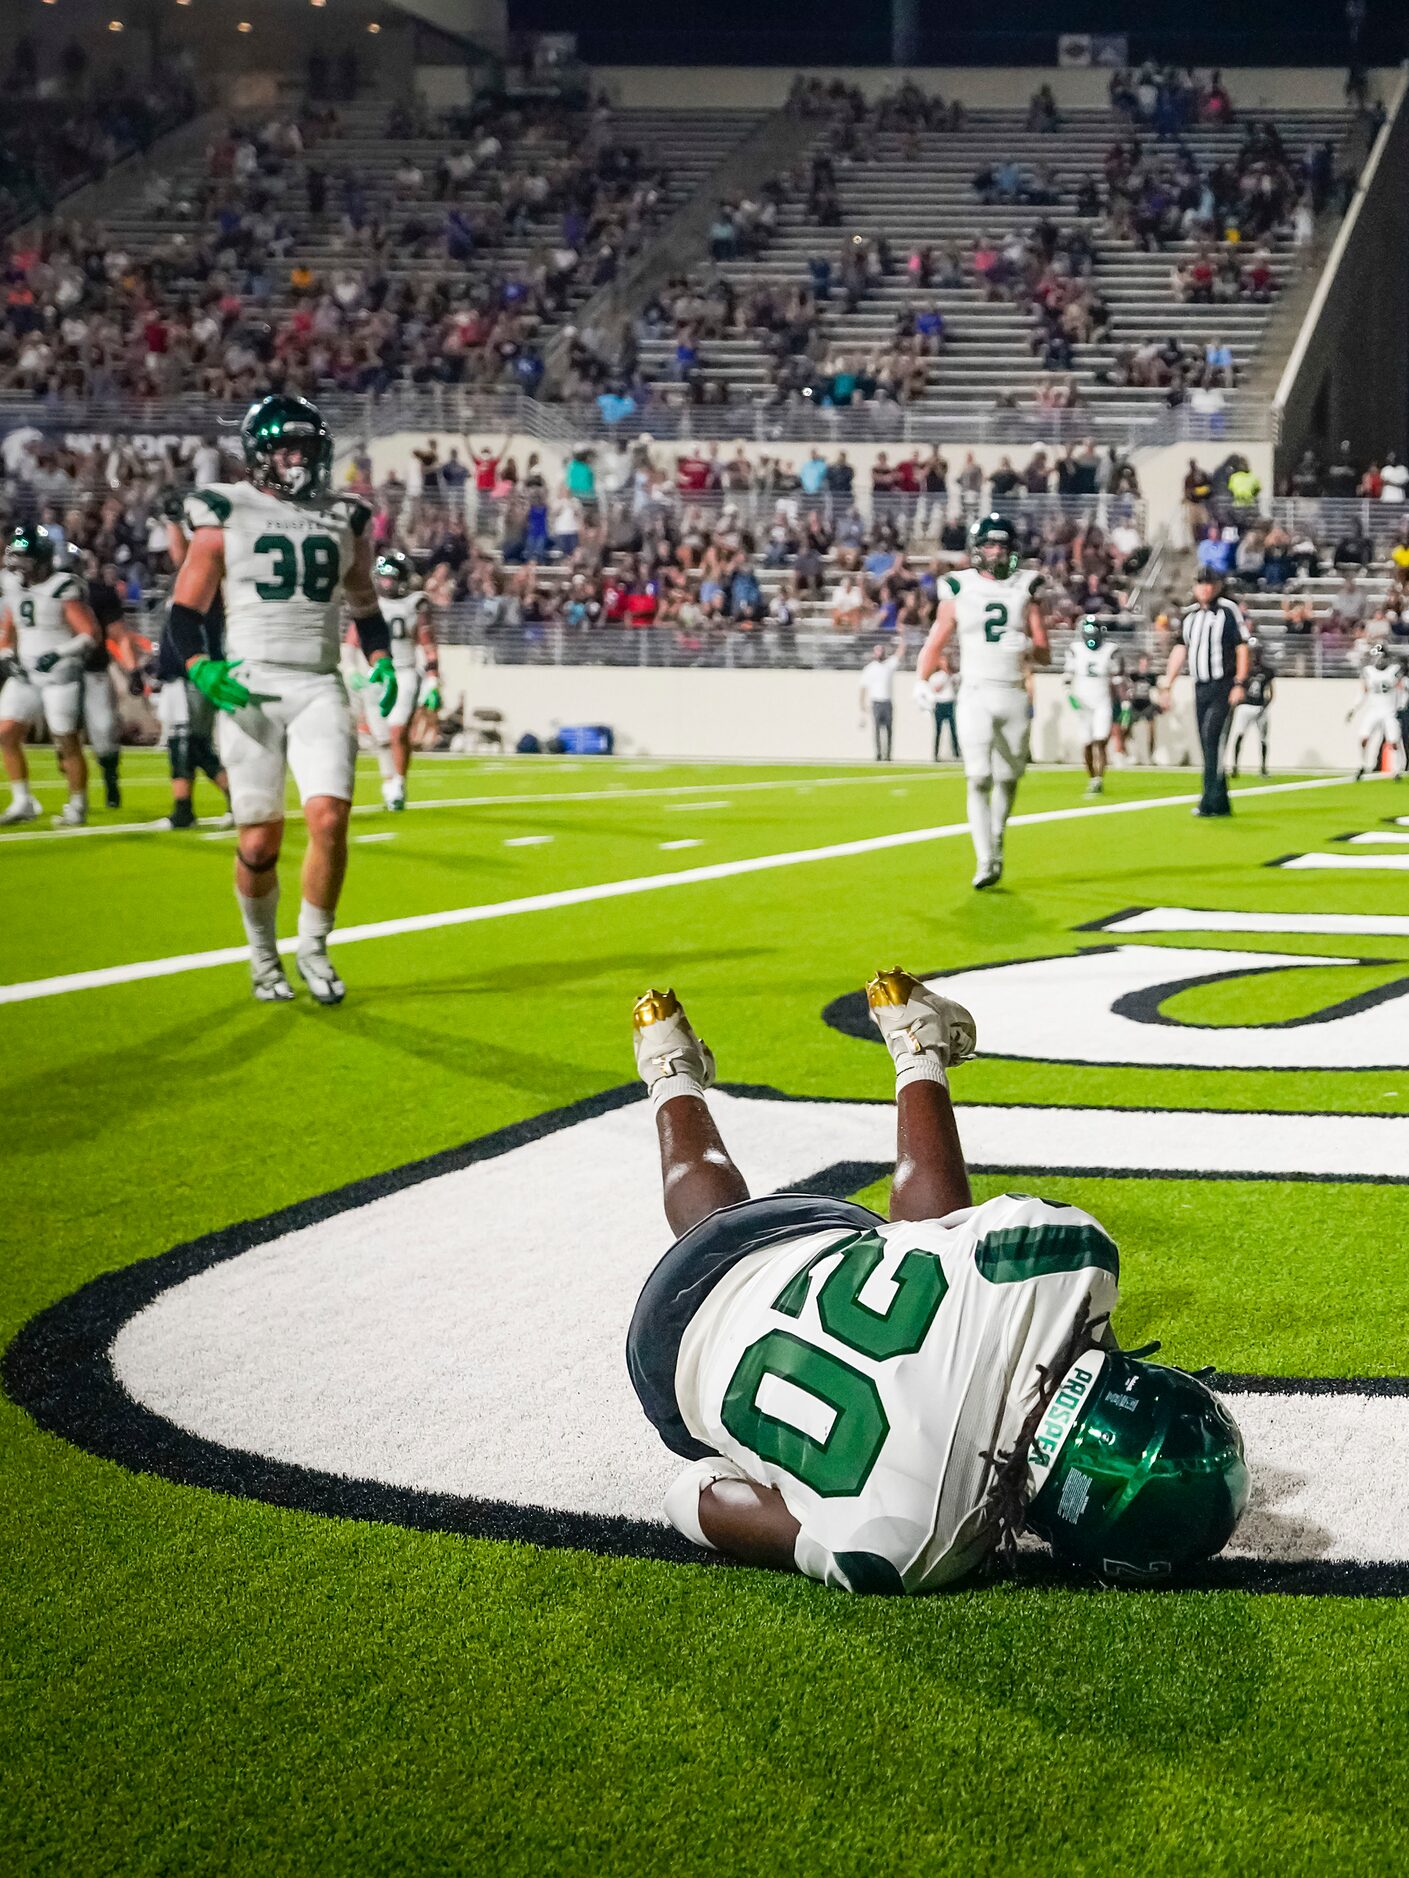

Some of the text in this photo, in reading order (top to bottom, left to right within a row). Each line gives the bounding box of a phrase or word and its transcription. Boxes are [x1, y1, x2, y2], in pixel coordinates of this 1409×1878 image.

[252, 532, 340, 603] 38
[20, 599, 36, 627] 9
[984, 602, 1008, 643] 2
[720, 1228, 949, 1498] 20
[1028, 1367, 1093, 1468] PROSPER
